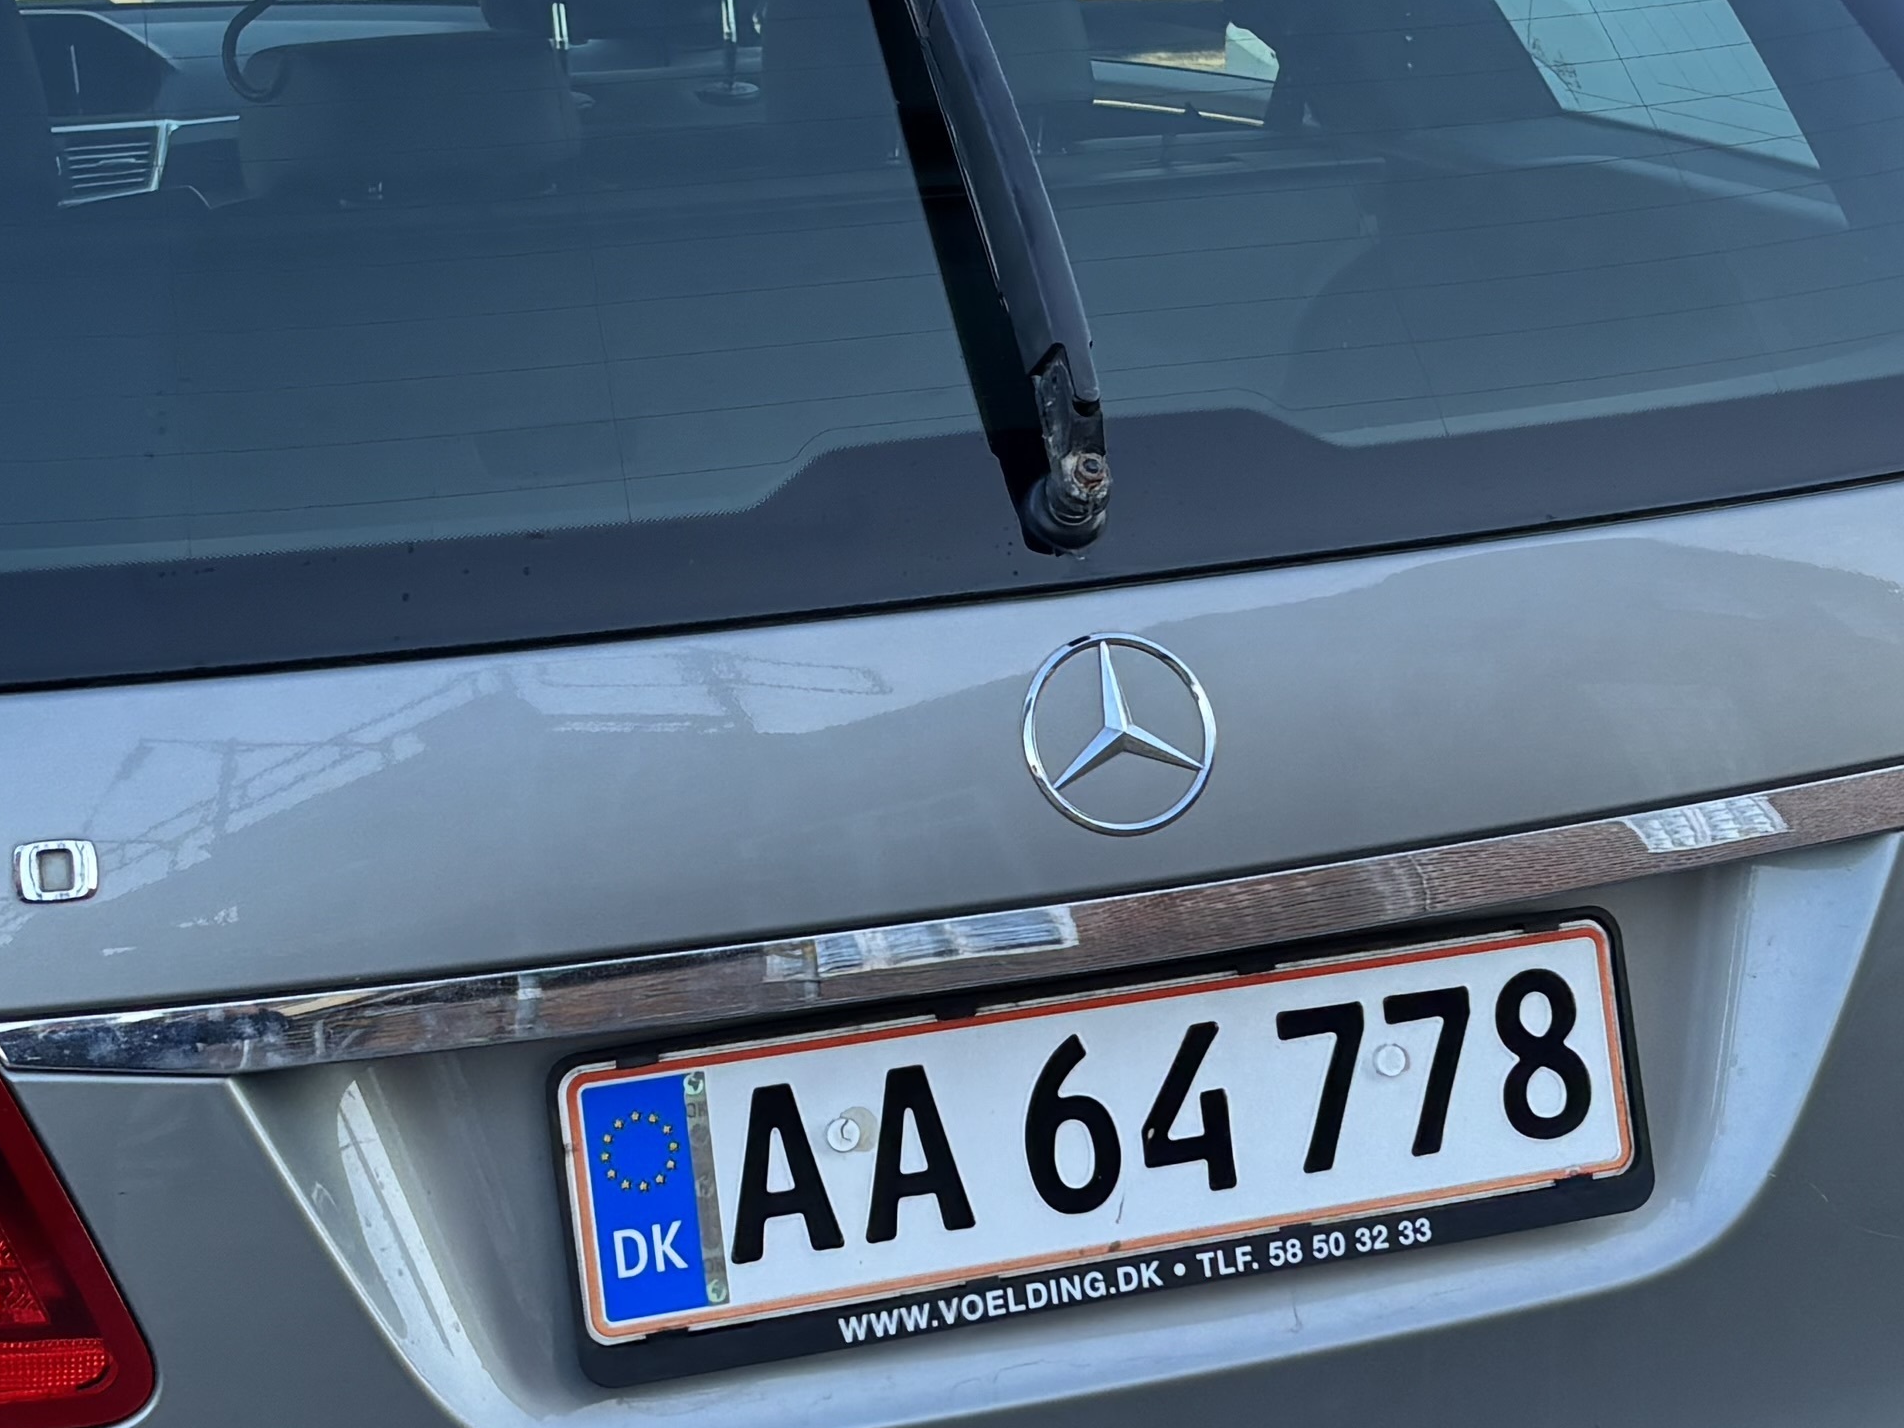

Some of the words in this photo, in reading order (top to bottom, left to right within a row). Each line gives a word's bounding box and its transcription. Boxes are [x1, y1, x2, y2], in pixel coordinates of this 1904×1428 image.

[731, 1064, 976, 1265] AA
[1024, 1021, 1237, 1215] 64
[1276, 968, 1592, 1174] 778
[613, 1220, 689, 1279] DK
[838, 1260, 1164, 1343] WWW.VOELDING.DK
[1195, 1245, 1259, 1278] TLF.
[1269, 1238, 1303, 1267] 58
[1312, 1231, 1346, 1259] 50
[1355, 1224, 1390, 1252] 32
[1398, 1217, 1432, 1245] 33
